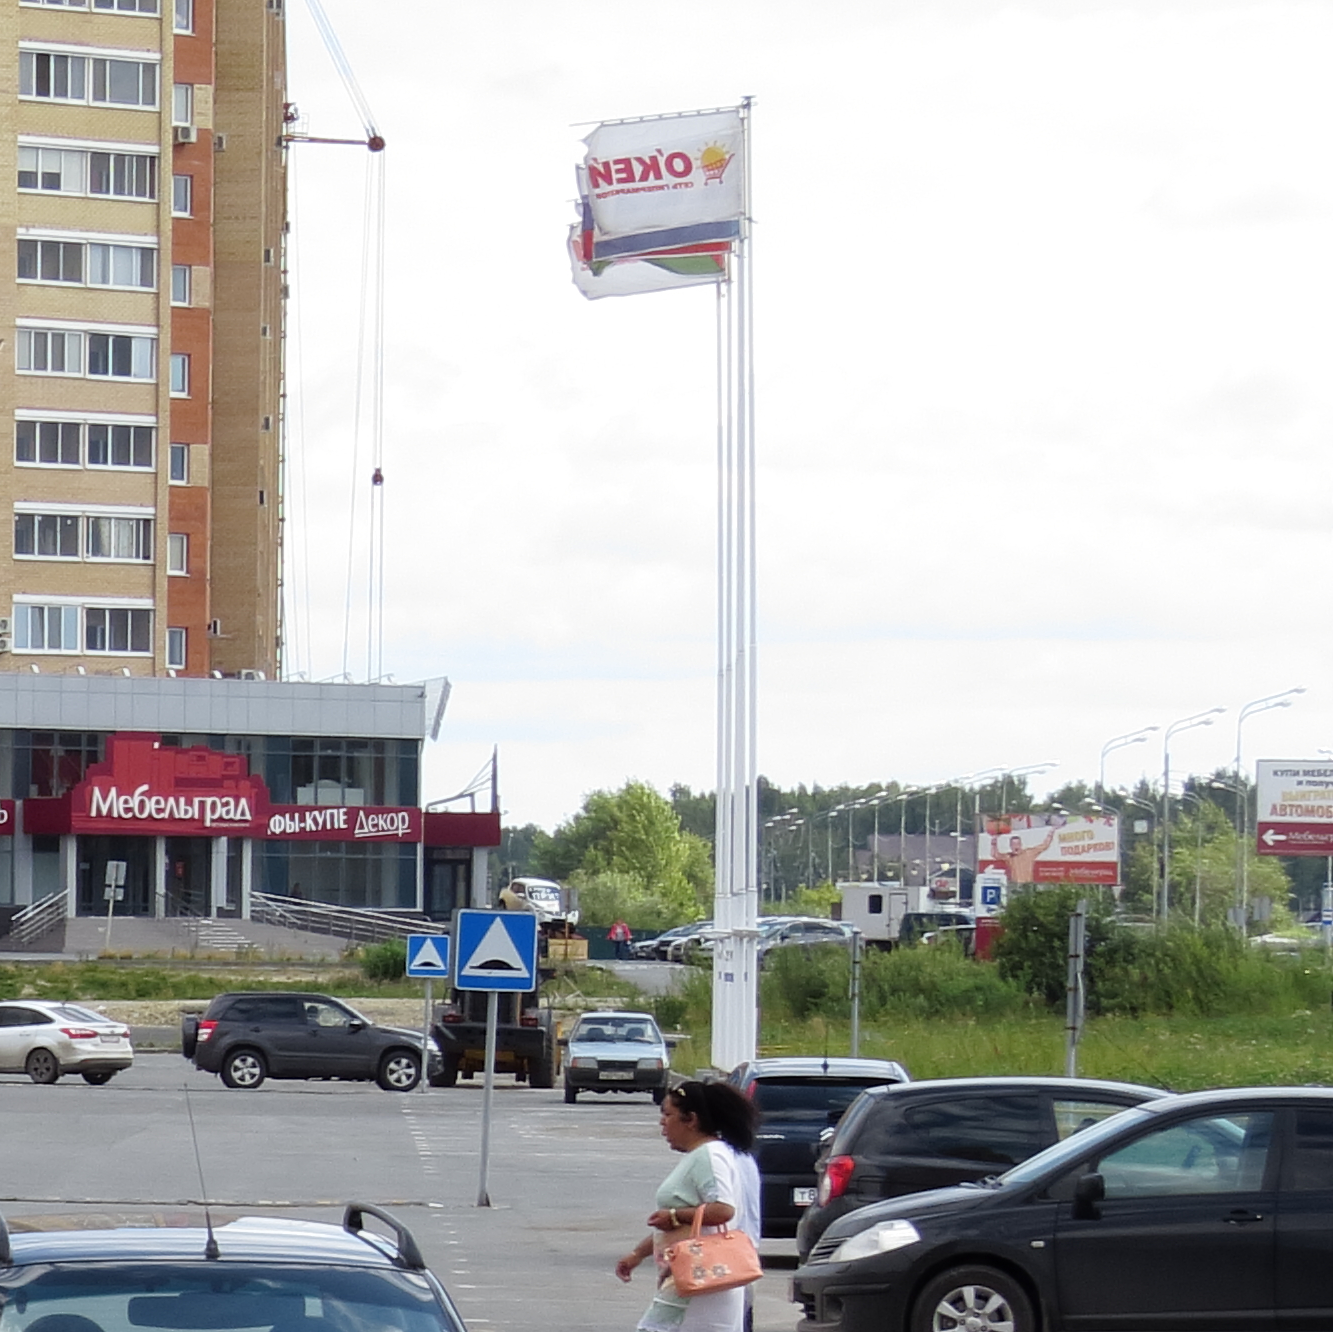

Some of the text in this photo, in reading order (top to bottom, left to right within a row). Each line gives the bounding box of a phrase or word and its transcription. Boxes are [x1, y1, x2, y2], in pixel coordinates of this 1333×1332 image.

[90, 784, 252, 827] Мебельград
[266, 808, 348, 835] ФЫ-КУПЕ
[354, 810, 412, 838] Декор
